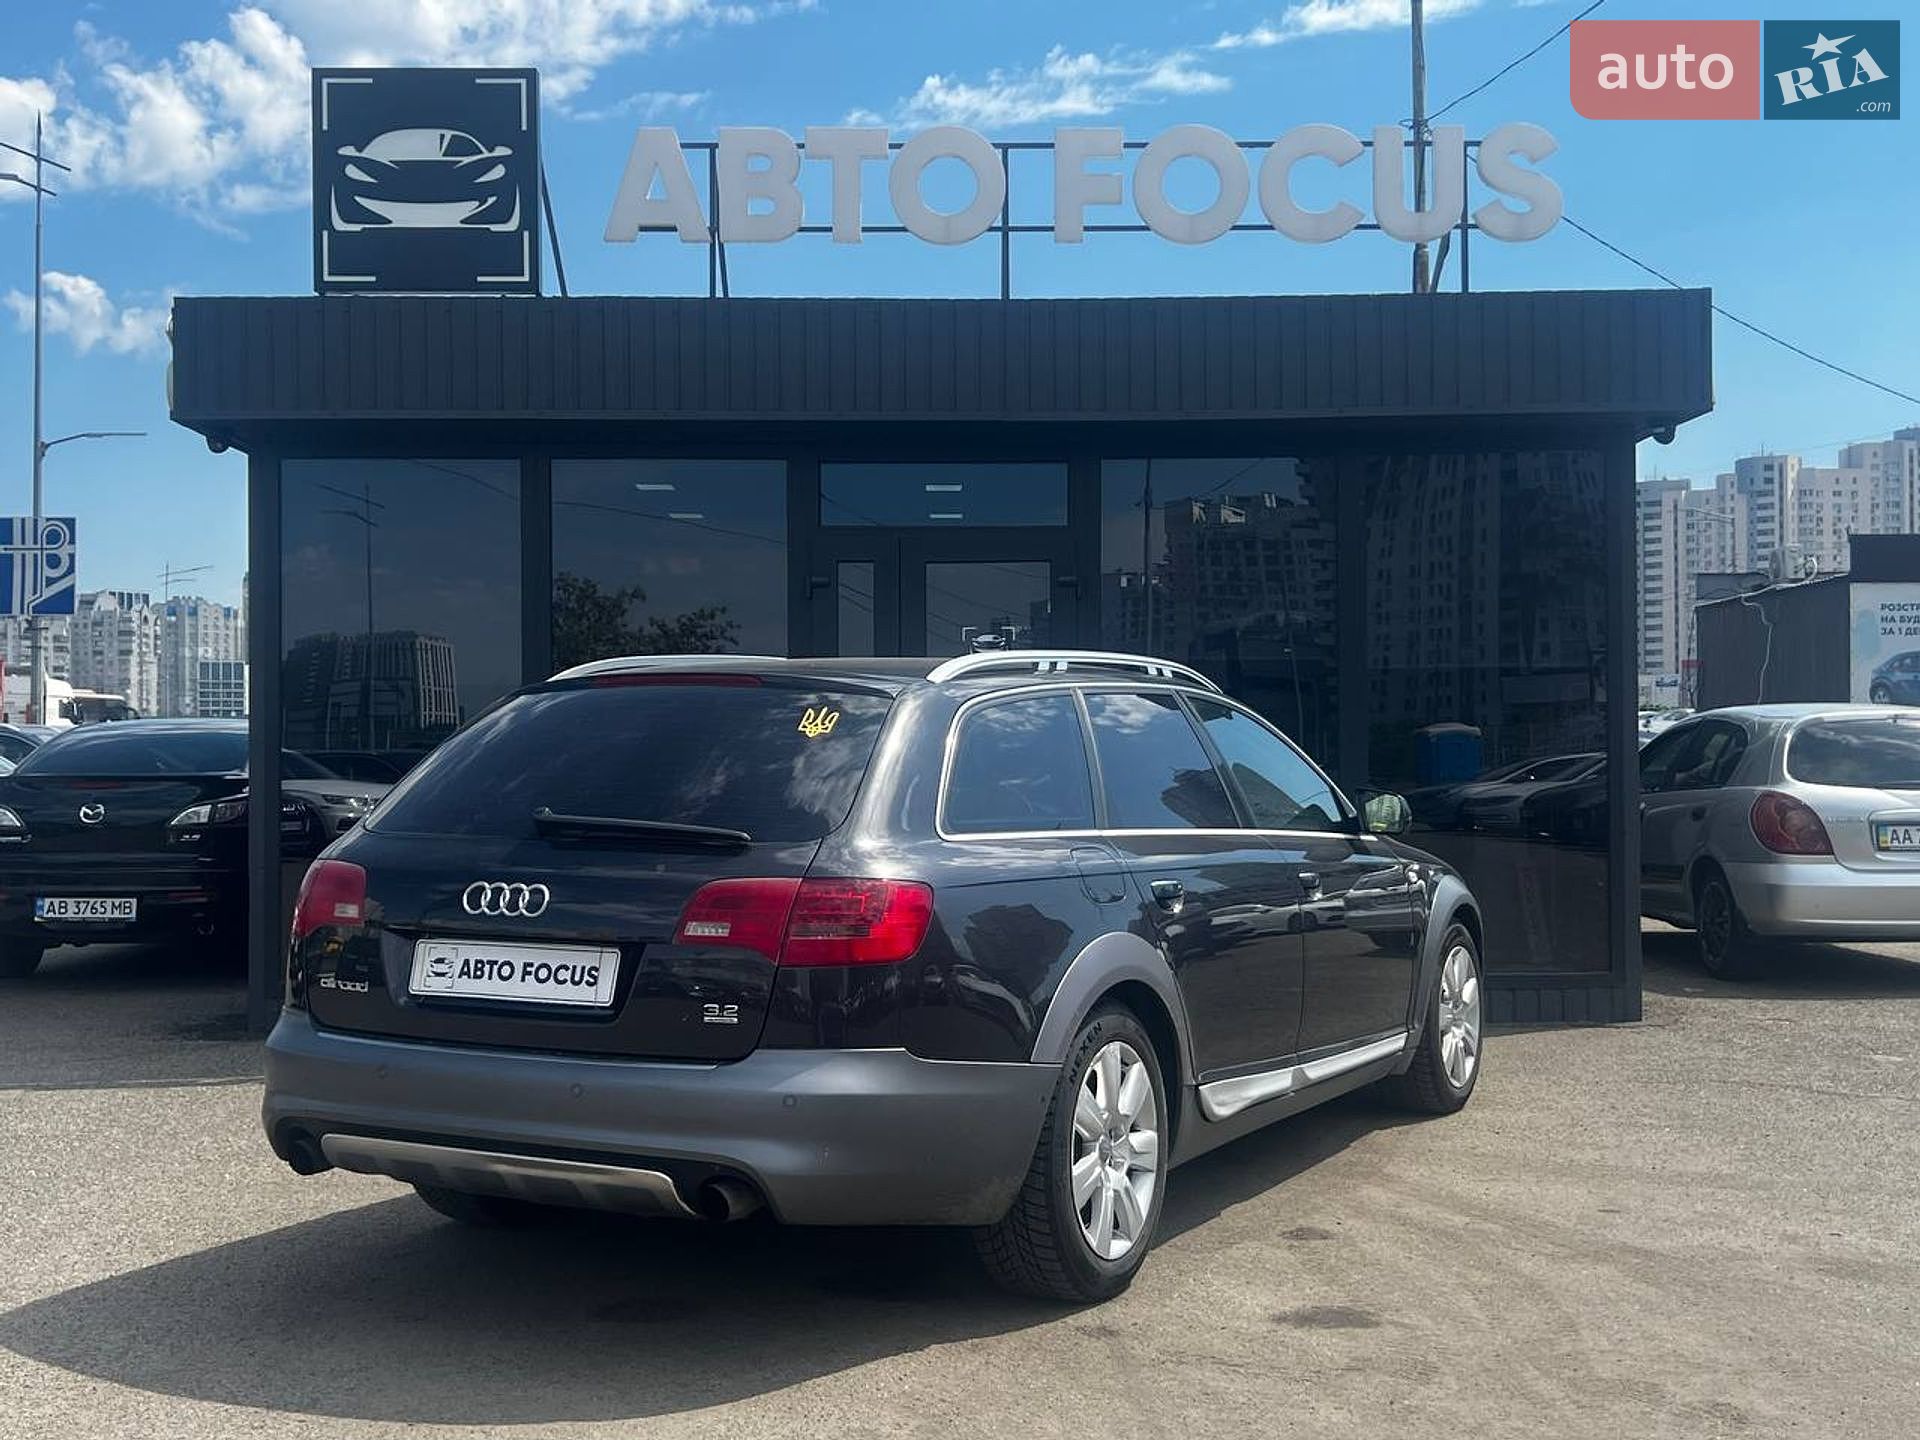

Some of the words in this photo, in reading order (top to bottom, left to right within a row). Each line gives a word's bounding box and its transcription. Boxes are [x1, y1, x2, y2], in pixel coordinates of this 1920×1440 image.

[604, 126, 1005, 244] АВТО
[1054, 123, 1564, 244] FOCUS
[1880, 615, 1896, 623] НА
[1880, 627, 1895, 636] ЗА
[1890, 828, 1914, 845] AA
[46, 900, 69, 915] AB
[72, 900, 107, 915] 3765
[110, 900, 132, 915] MB
[458, 958, 515, 981] АВТО
[520, 962, 600, 987] FOCUS
[703, 1003, 739, 1017] 3.2
